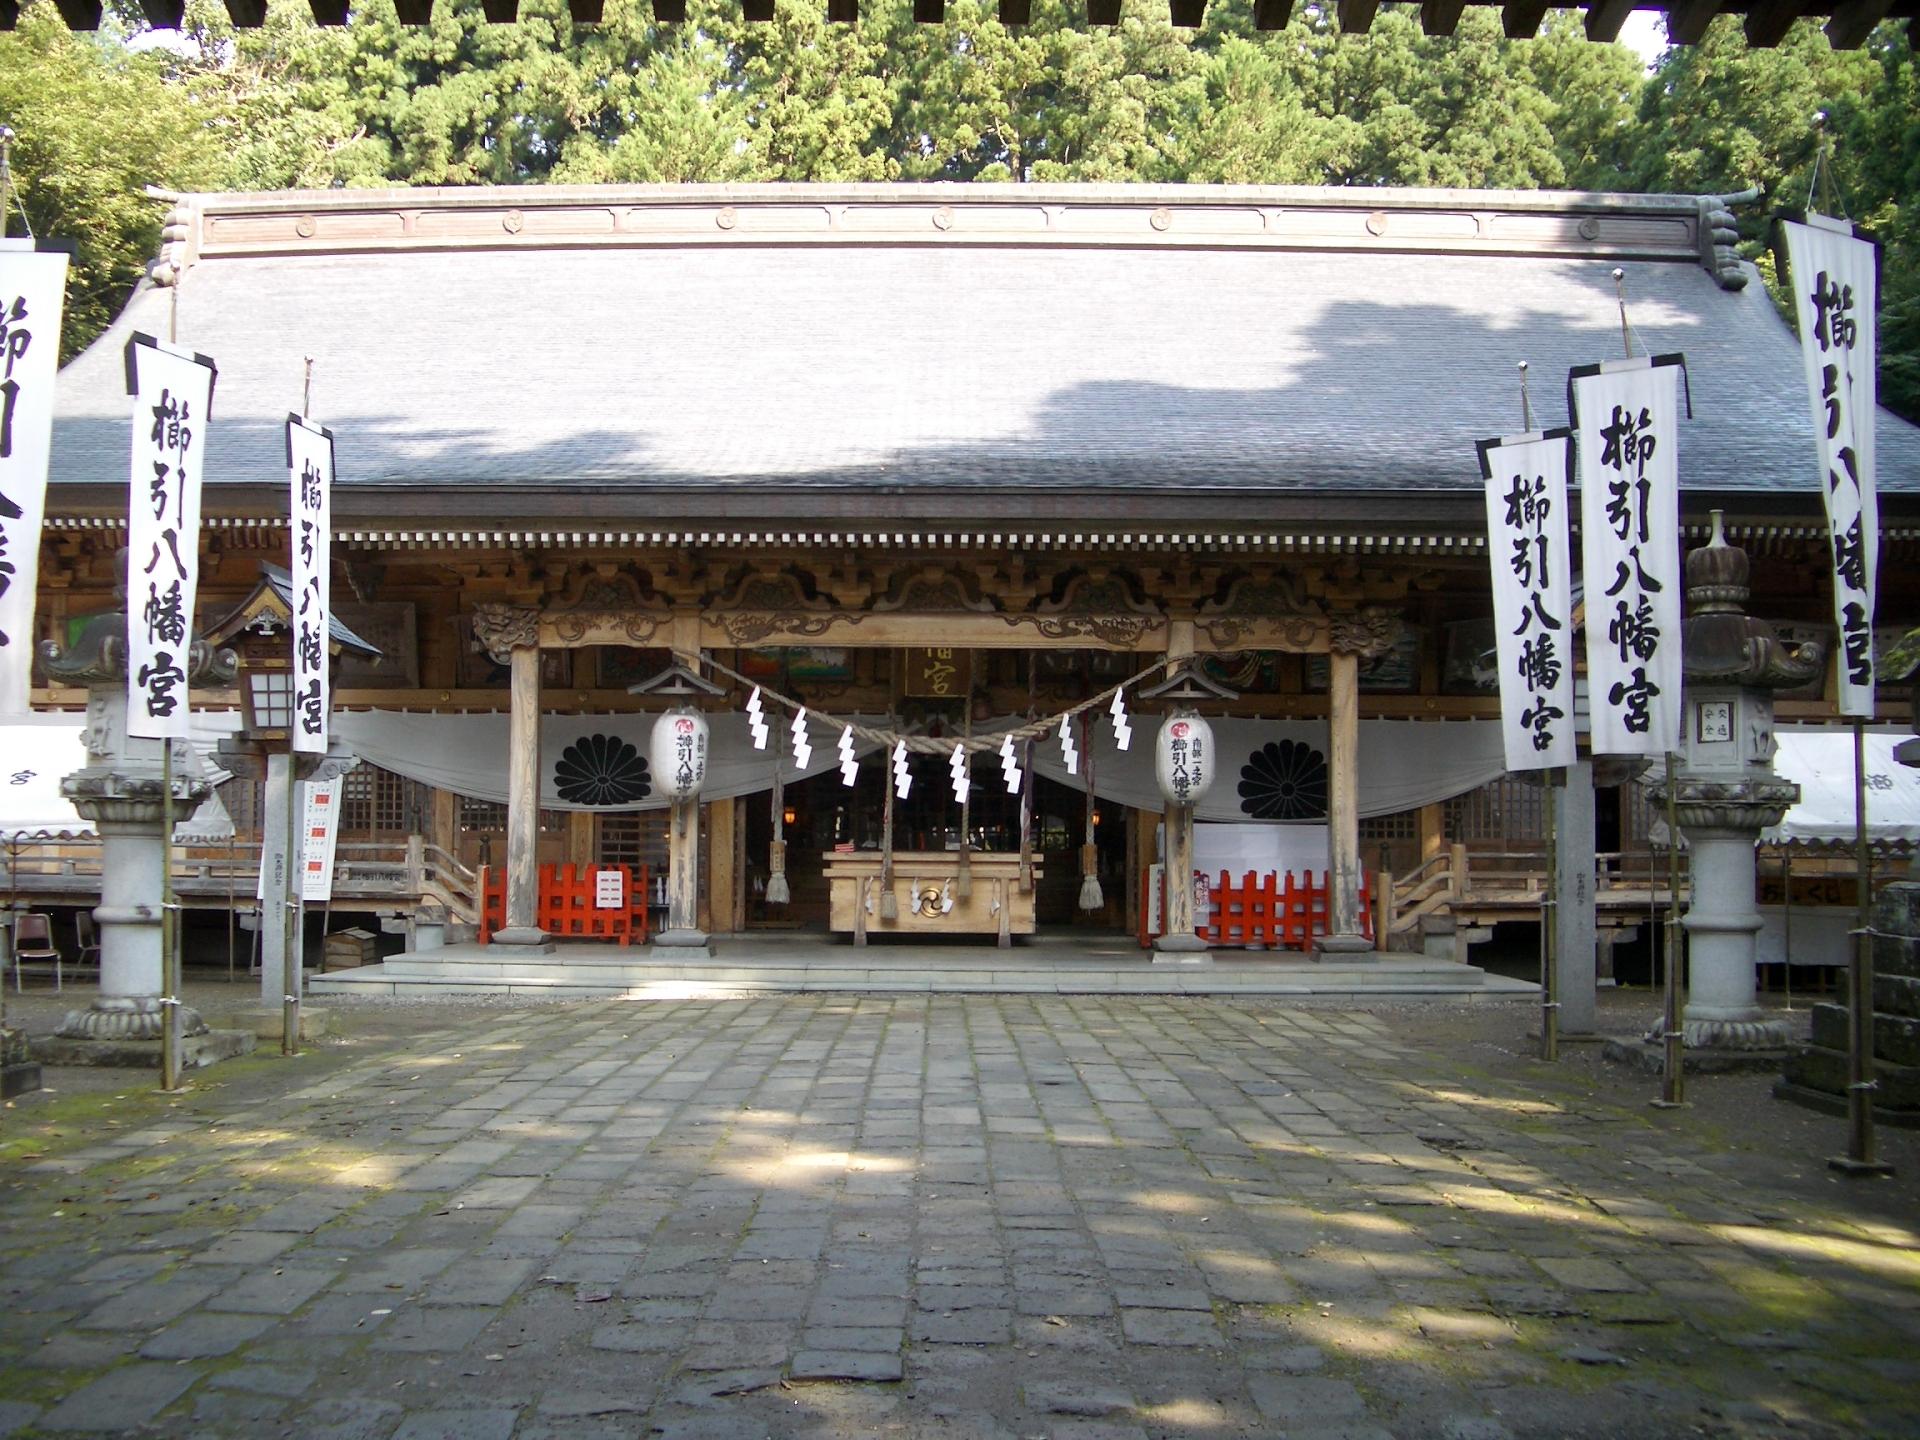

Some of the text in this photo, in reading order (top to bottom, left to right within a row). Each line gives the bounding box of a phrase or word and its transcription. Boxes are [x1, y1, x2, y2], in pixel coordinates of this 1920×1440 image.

[138, 388, 192, 717] 櫛引八幡宮
[297, 458, 322, 734] 櫛引八幡宮
[1503, 474, 1564, 751] 櫛引八幡宮
[1600, 405, 1663, 734] 櫛引八幡宮
[1171, 738, 1191, 799] 櫛引八幡宮
